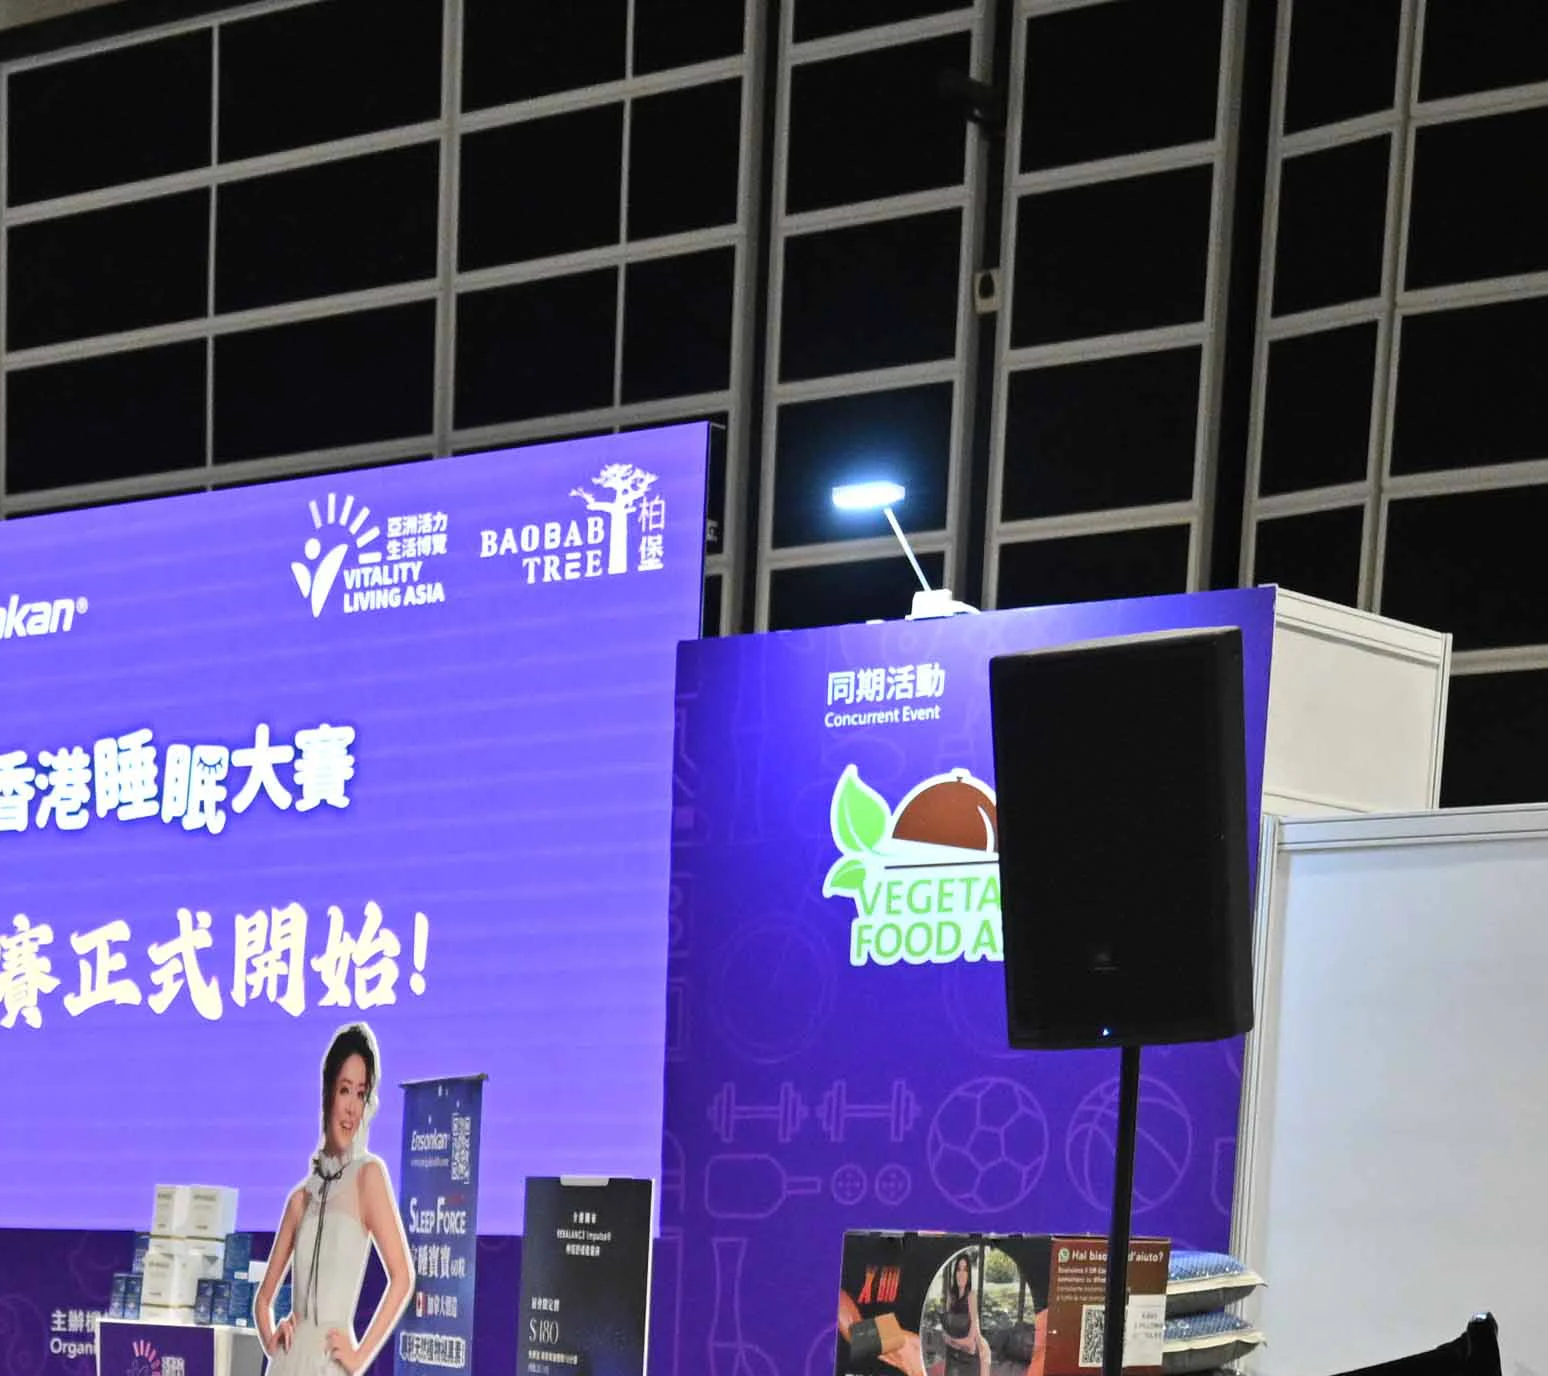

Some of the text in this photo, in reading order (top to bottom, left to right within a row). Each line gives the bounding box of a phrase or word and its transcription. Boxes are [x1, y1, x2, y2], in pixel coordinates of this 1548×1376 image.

[386, 511, 448, 539] 亞洲活力
[479, 516, 605, 559] BAOBAB
[637, 495, 667, 573] 柏堡
[385, 533, 448, 562] 生活博覽
[343, 561, 423, 590] VITALITY
[522, 549, 603, 584] TREE
[343, 582, 445, 614] LIVING ASIA
[826, 662, 945, 706] 同期活動
[824, 703, 940, 729] Concurrent Event
[859, 875, 1001, 917] VEGETA
[855, 918, 1000, 963] FOOD A
[1089, 1252, 1108, 1263] biso
